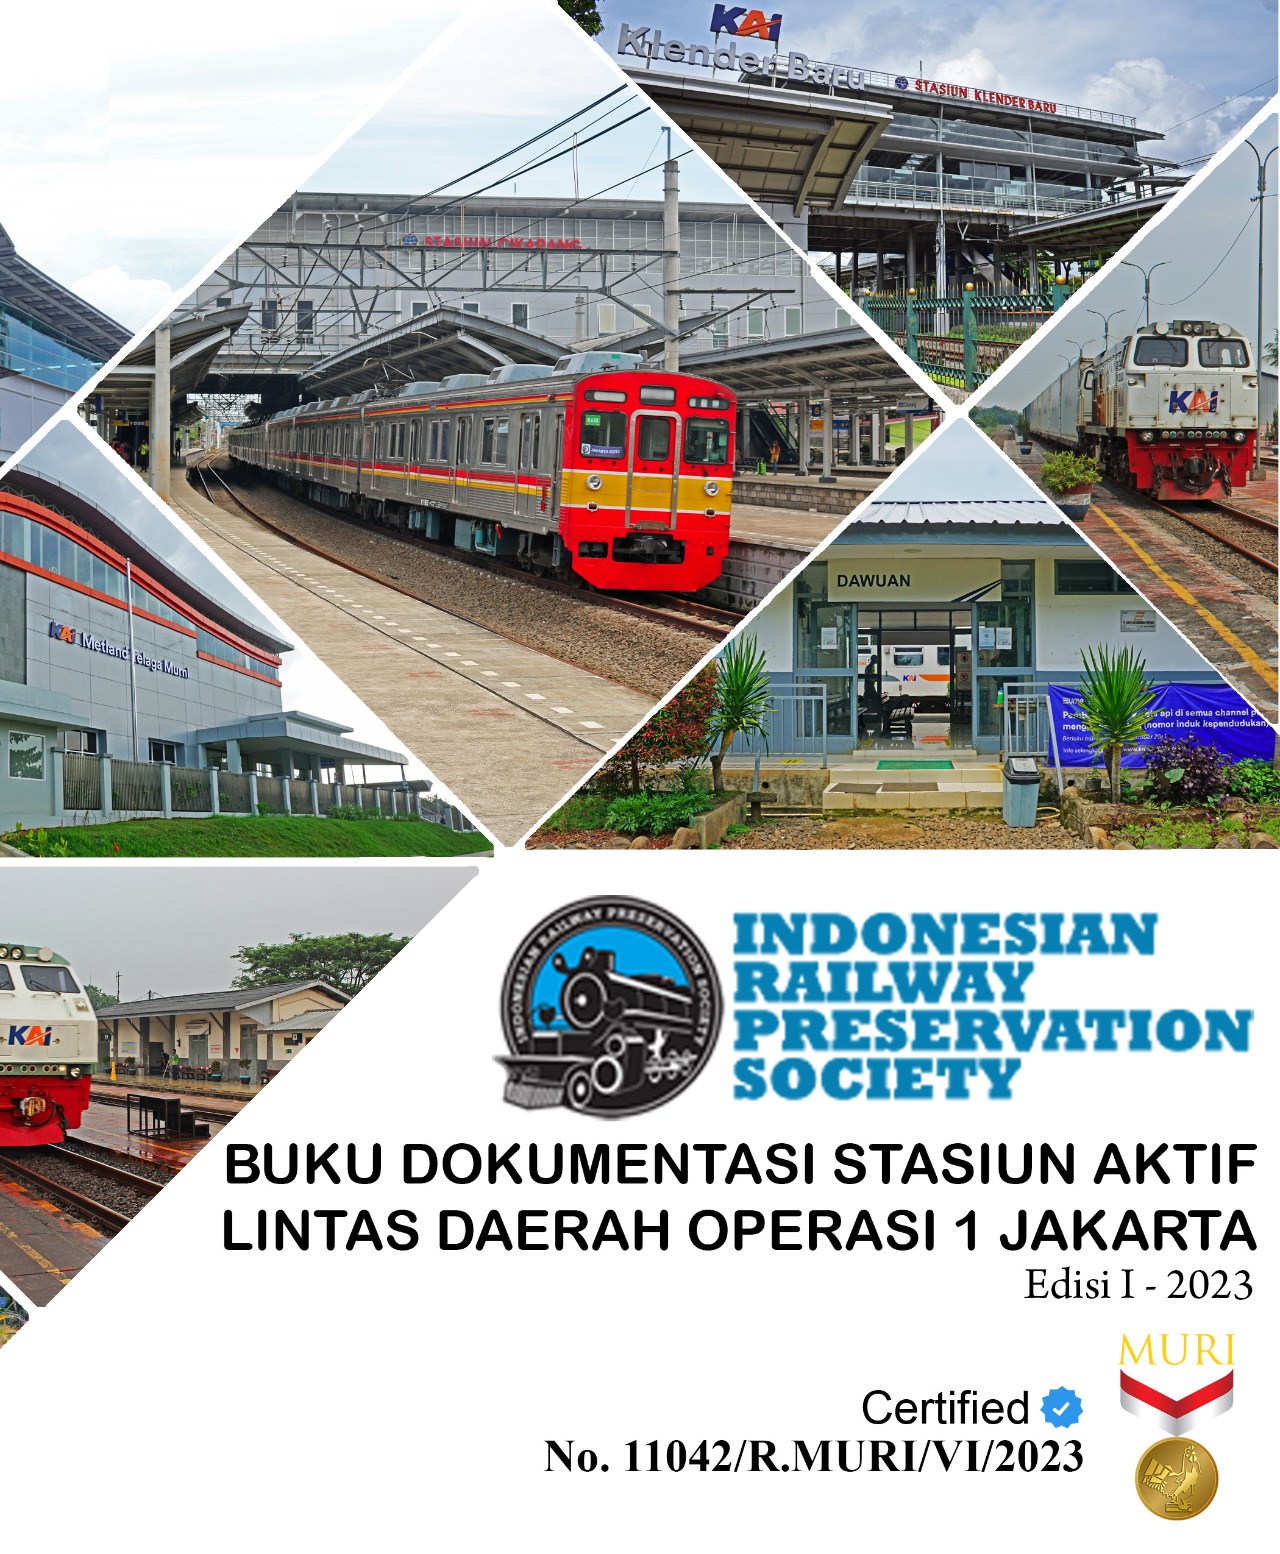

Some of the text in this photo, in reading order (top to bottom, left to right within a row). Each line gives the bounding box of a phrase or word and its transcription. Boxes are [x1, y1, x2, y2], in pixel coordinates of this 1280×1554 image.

[710, 4, 782, 41] KAI
[618, 23, 865, 91] Klender Baru
[915, 79, 1057, 114] STASIUN KLENDER BARU
[1169, 390, 1219, 414] KAI
[837, 574, 911, 587] DAWUAN
[49, 620, 76, 644] KAI
[81, 632, 129, 661] Metland
[163, 659, 190, 679] Murni
[1160, 709, 1173, 718] api
[1175, 708, 1183, 717] di
[1215, 708, 1249, 717] channel
[1176, 720, 1200, 728] induk
[8, 1025, 52, 1047] KAI
